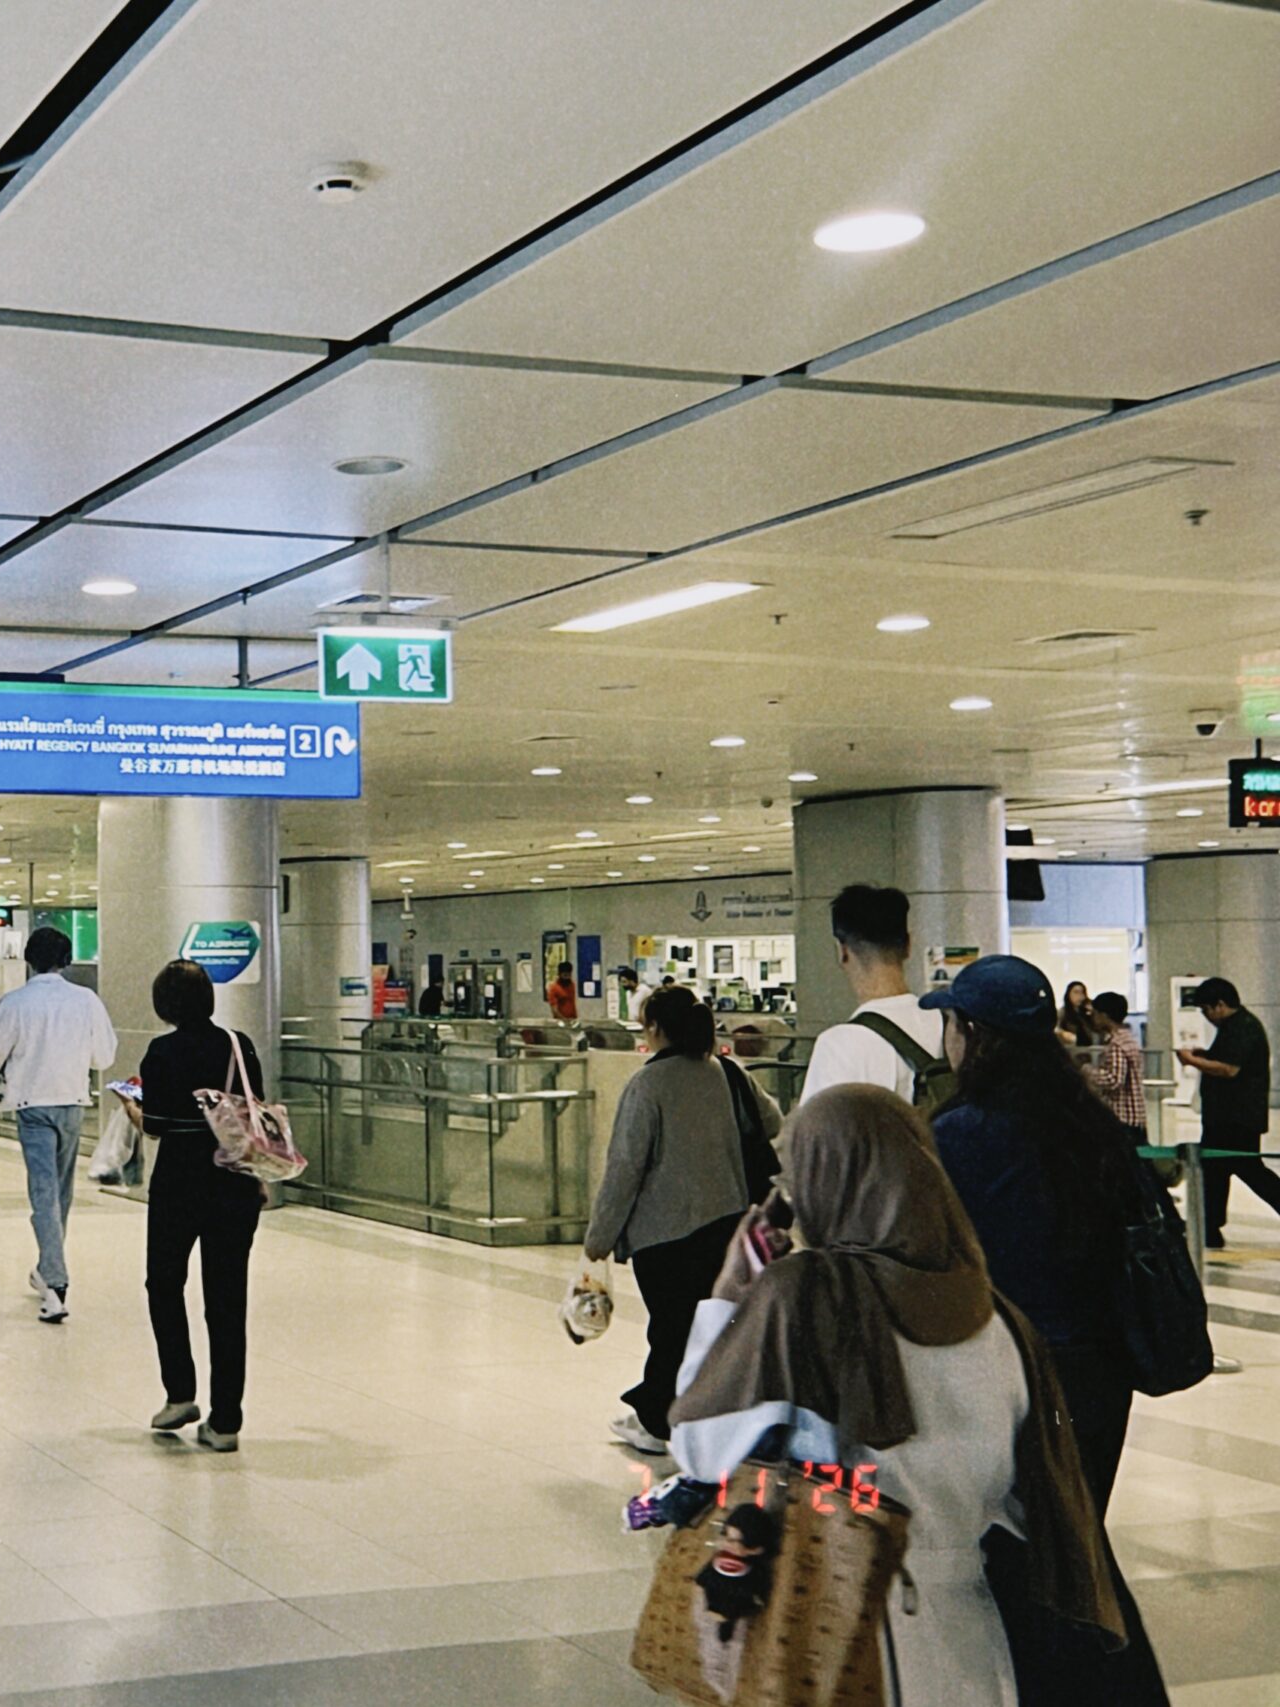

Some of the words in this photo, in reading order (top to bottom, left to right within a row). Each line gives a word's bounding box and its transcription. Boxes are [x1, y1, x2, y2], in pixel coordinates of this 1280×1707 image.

[0, 738, 35, 751] HYATT
[36, 739, 90, 752] REGENCY
[91, 740, 146, 754] BANGKOK
[298, 732, 312, 751] 2
[194, 940, 207, 948] TO
